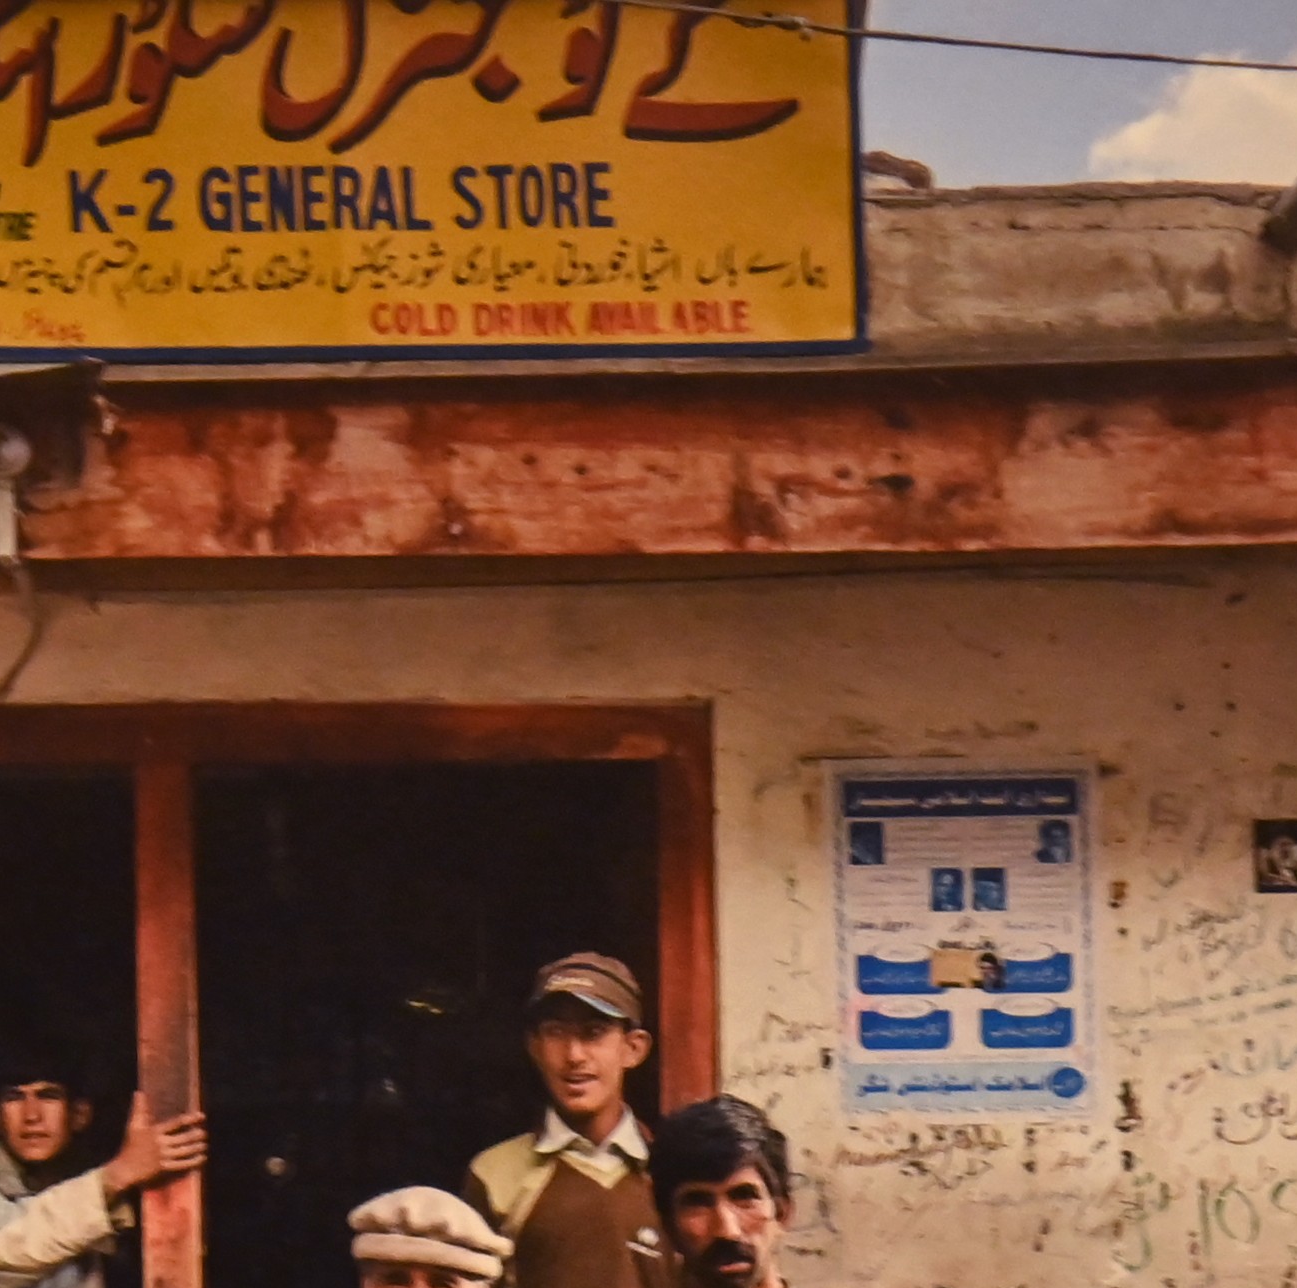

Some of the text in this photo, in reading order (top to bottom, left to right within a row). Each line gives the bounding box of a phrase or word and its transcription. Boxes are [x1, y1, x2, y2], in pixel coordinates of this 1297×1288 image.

[68, 162, 616, 233] K-2 GENERAL STORE
[370, 302, 457, 336] COLD
[472, 301, 577, 336] DRINK
